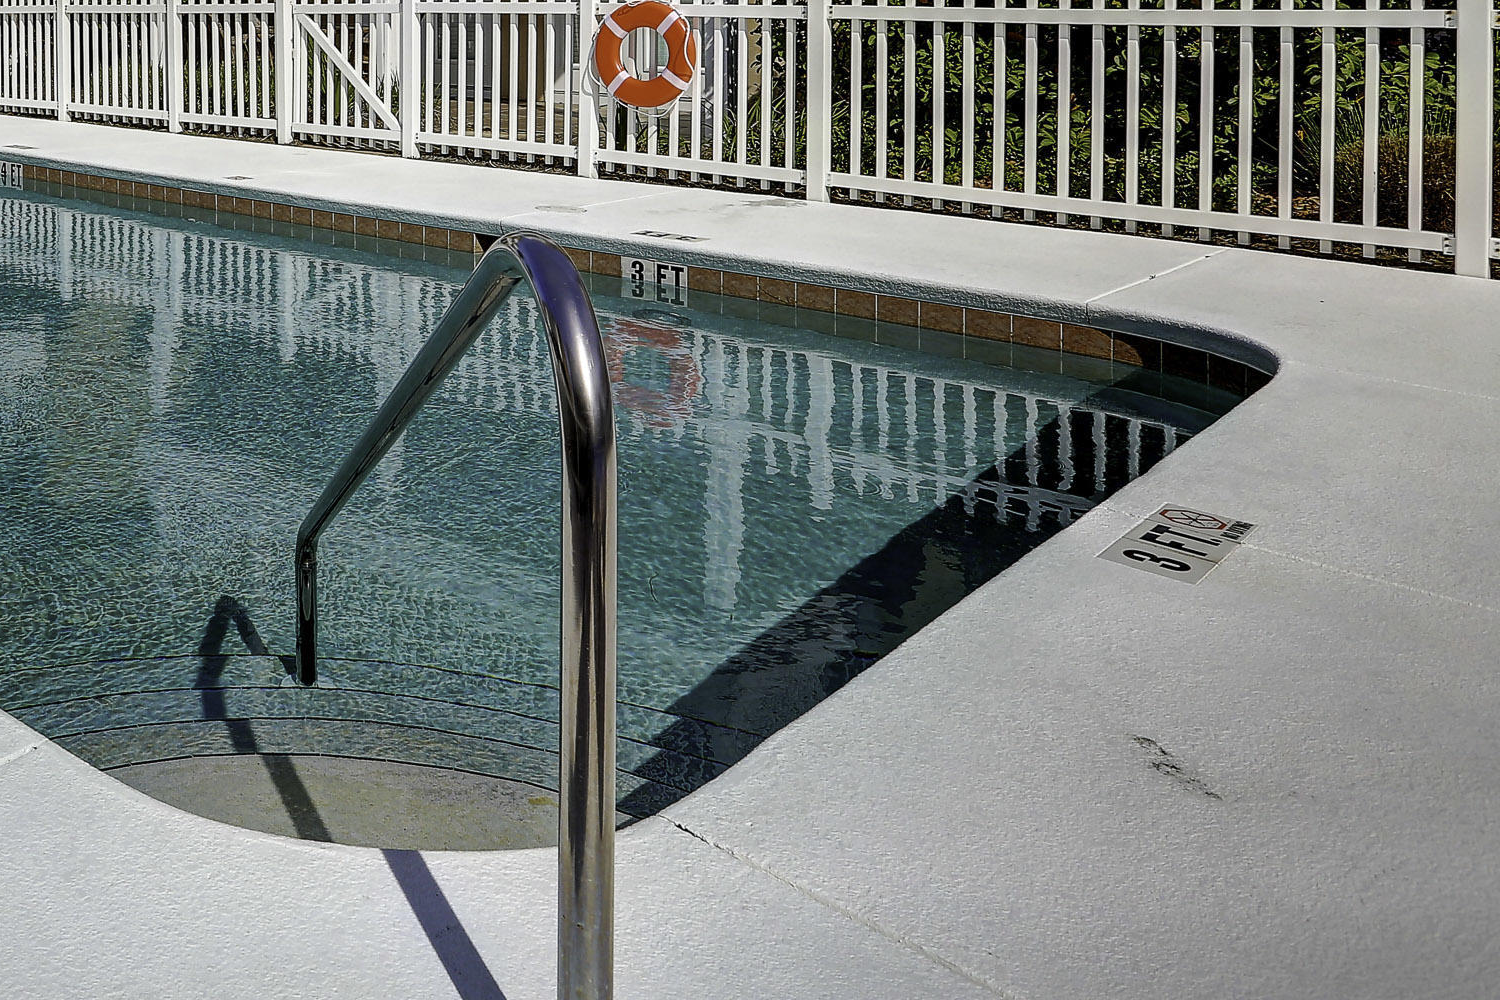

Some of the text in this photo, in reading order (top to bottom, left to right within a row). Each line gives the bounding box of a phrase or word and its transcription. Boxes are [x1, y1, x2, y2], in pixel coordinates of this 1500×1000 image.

[631, 261, 684, 287] 3 FT
[1122, 550, 1192, 572] 3
